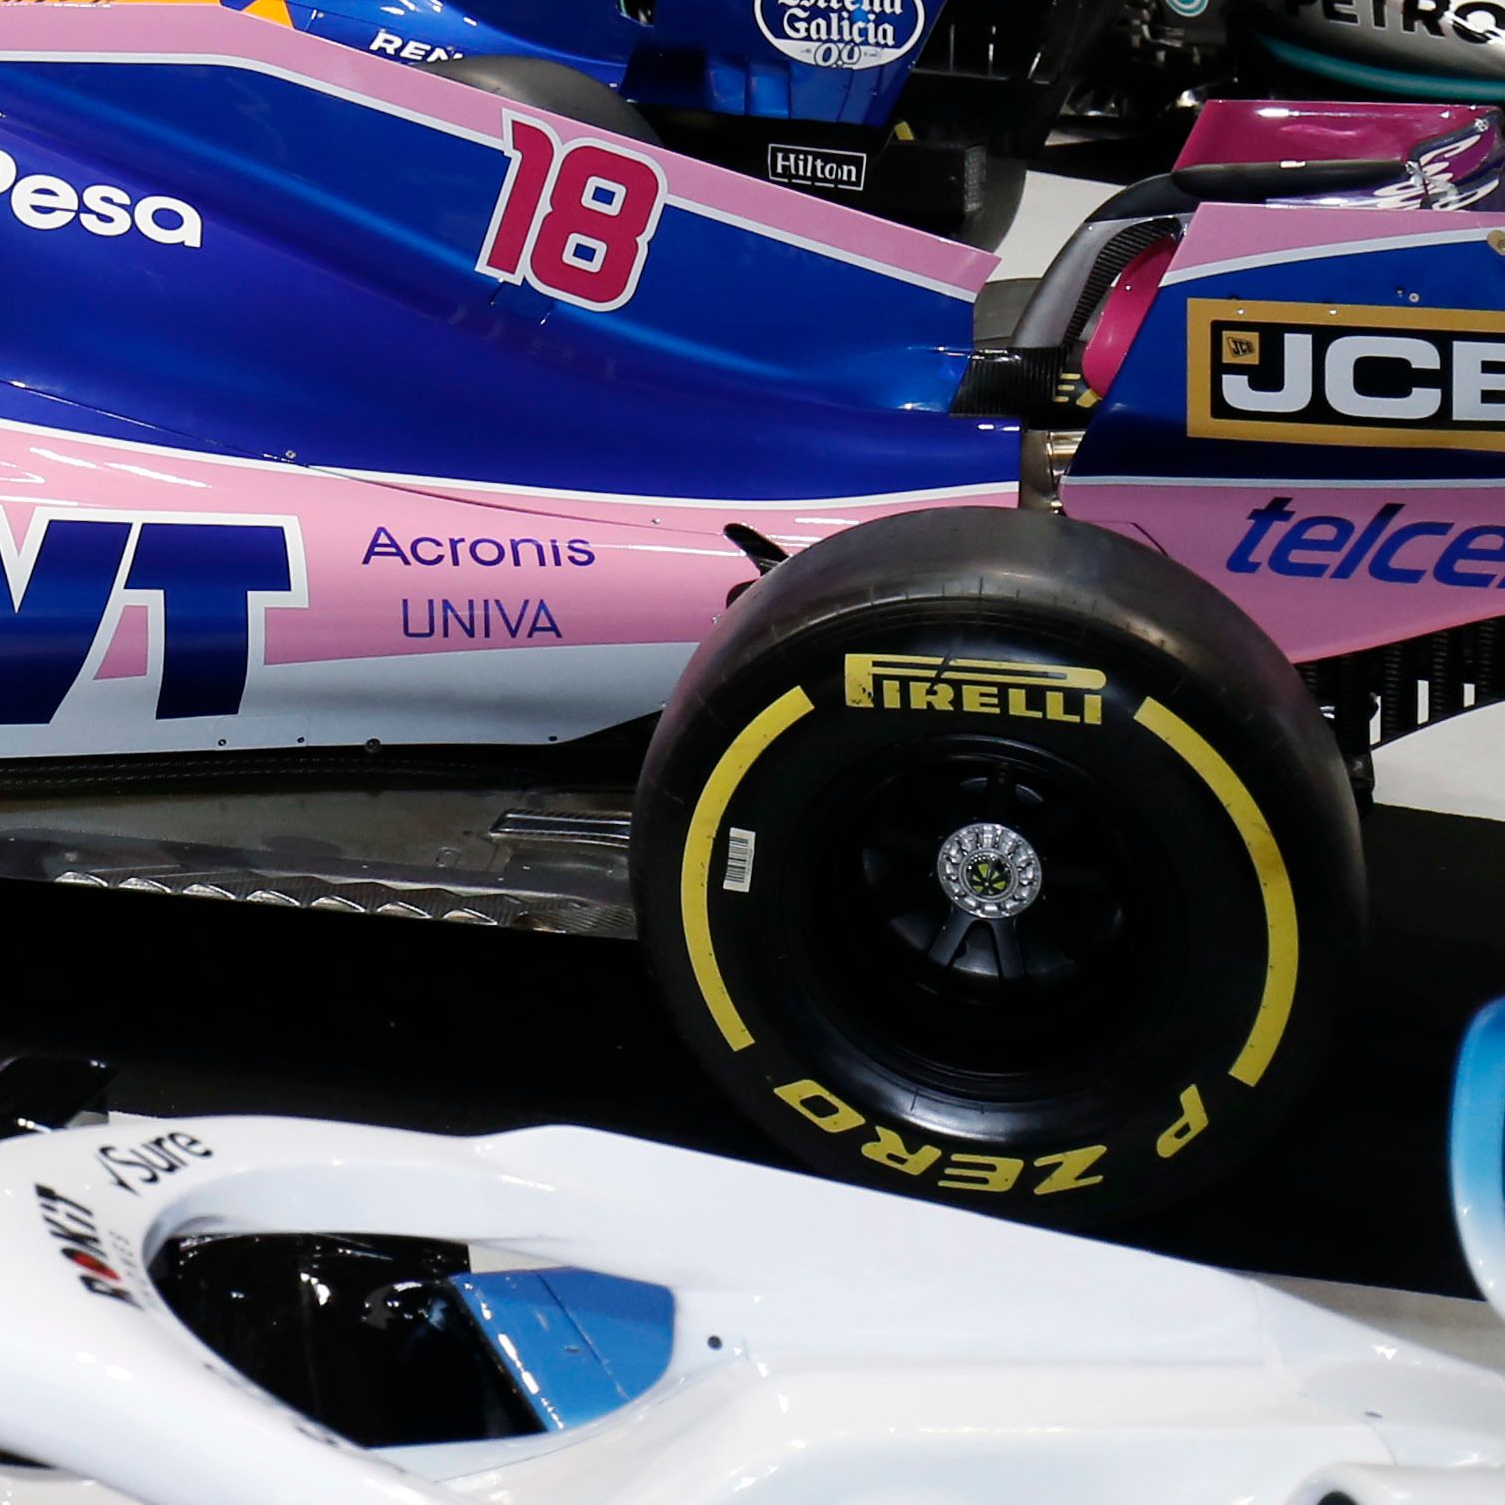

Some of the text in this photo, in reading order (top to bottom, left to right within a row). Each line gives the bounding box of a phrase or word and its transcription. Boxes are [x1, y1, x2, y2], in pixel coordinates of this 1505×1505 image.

[782, 8, 896, 47] Galicia
[775, 151, 858, 183] Hilton
[481, 115, 667, 308] 18
[361, 526, 597, 568] Acronis
[1226, 496, 1505, 589] telce
[401, 598, 564, 640] UNIVA
[844, 653, 1109, 725] PIRELLI
[774, 1078, 1210, 1197] P ZERO
